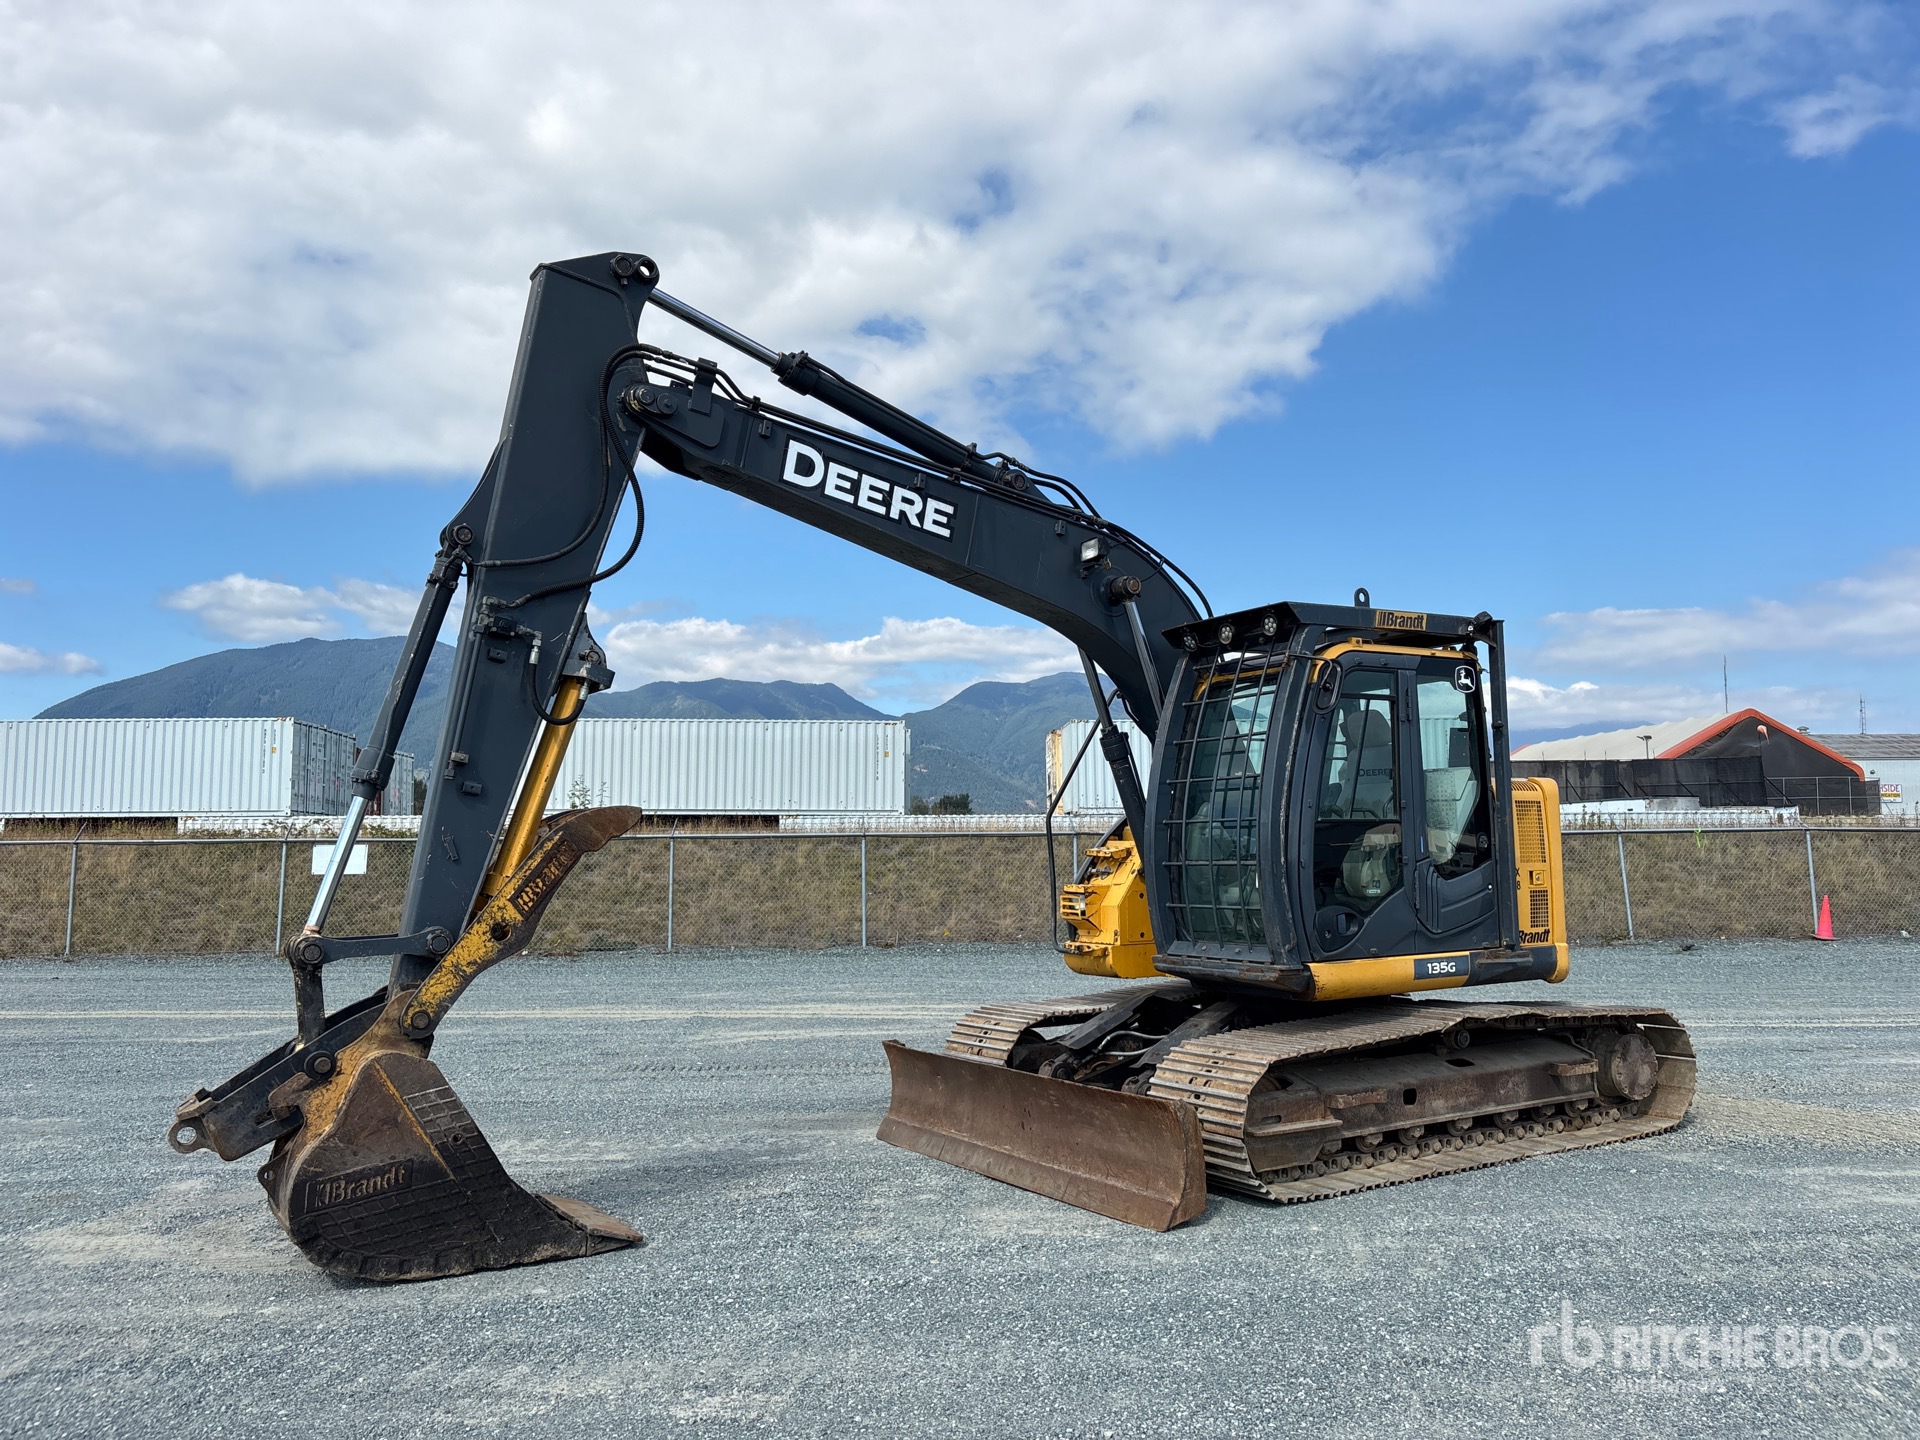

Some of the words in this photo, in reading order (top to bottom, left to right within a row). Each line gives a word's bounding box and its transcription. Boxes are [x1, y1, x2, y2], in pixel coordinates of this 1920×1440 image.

[782, 439, 955, 538] DEERE
[1386, 611, 1424, 629] Brandt
[1427, 961, 1456, 975] 135G
[330, 1163, 406, 1203] Brandt
